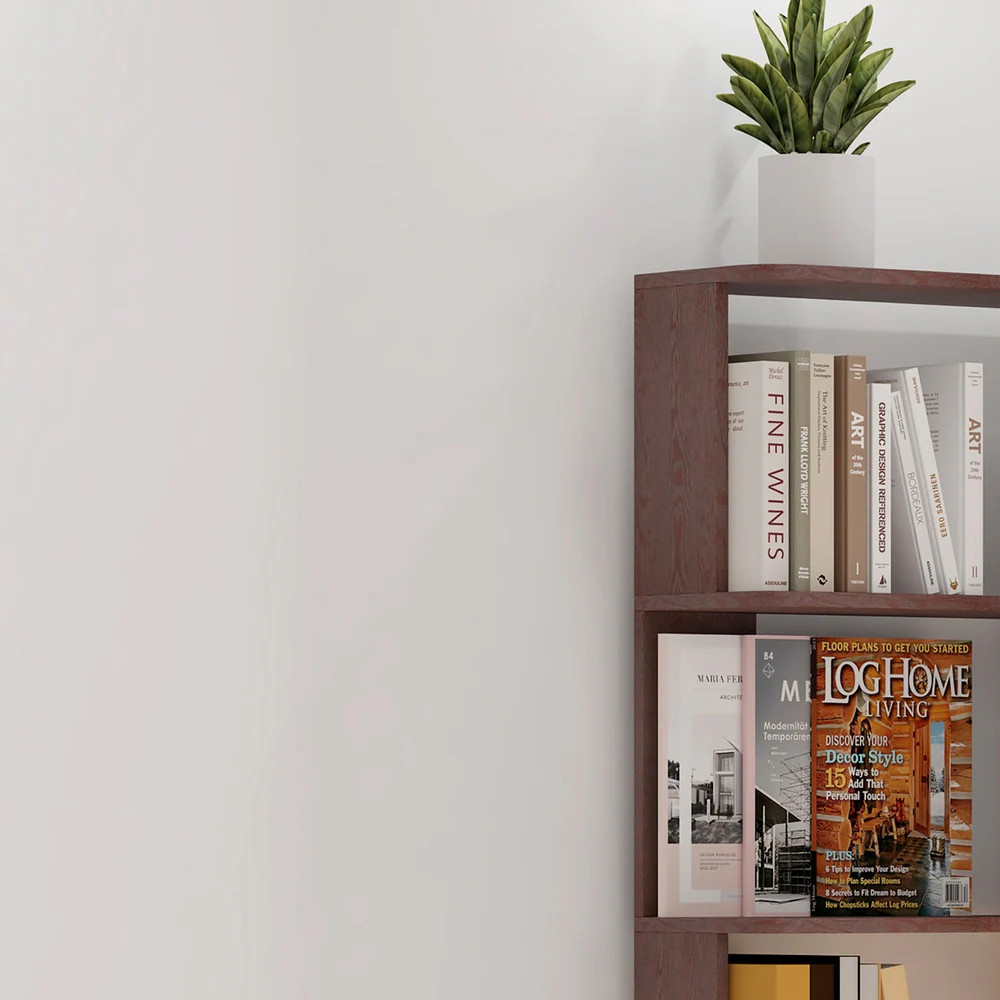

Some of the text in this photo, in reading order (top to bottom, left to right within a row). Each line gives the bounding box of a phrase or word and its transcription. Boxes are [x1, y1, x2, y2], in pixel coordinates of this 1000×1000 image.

[767, 393, 785, 454] FINE
[850, 411, 865, 449] ART
[878, 402, 886, 446] GRAPHIC
[968, 417, 982, 454] ART
[800, 426, 809, 515] FRANK LLOYD WRIGHT
[878, 449, 886, 485] DESIGN
[907, 472, 925, 525] BORDEAUX
[930, 473, 948, 538] EERO SAARINEN
[767, 468, 785, 560] WINES
[878, 488, 886, 553] REFERENCED
[821, 641, 849, 652] FLOOR
[851, 641, 879, 653] PLANS
[880, 642, 892, 653] TO
[894, 643, 910, 653] GET
[912, 643, 930, 654] YOU
[932, 644, 969, 654] STARTED
[697, 674, 744, 683] MARIA FER
[866, 700, 928, 718] LIVING
[763, 721, 808, 731] Modernität
[825, 735, 888, 747] DISCOVER YOUR
[825, 749, 904, 768] Decor Style
[825, 767, 847, 788] 15
[847, 767, 879, 778] Ways to
[847, 779, 884, 788] Add That
[825, 790, 886, 801] Personal Touch
[825, 851, 855, 861] PLUS:
[831, 865, 843, 873] Tips
[851, 865, 875, 873] Improve
[890, 865, 910, 874] Design
[860, 877, 881, 886] Special
[897, 889, 917, 898] Budget
[889, 901, 900, 910] Log
